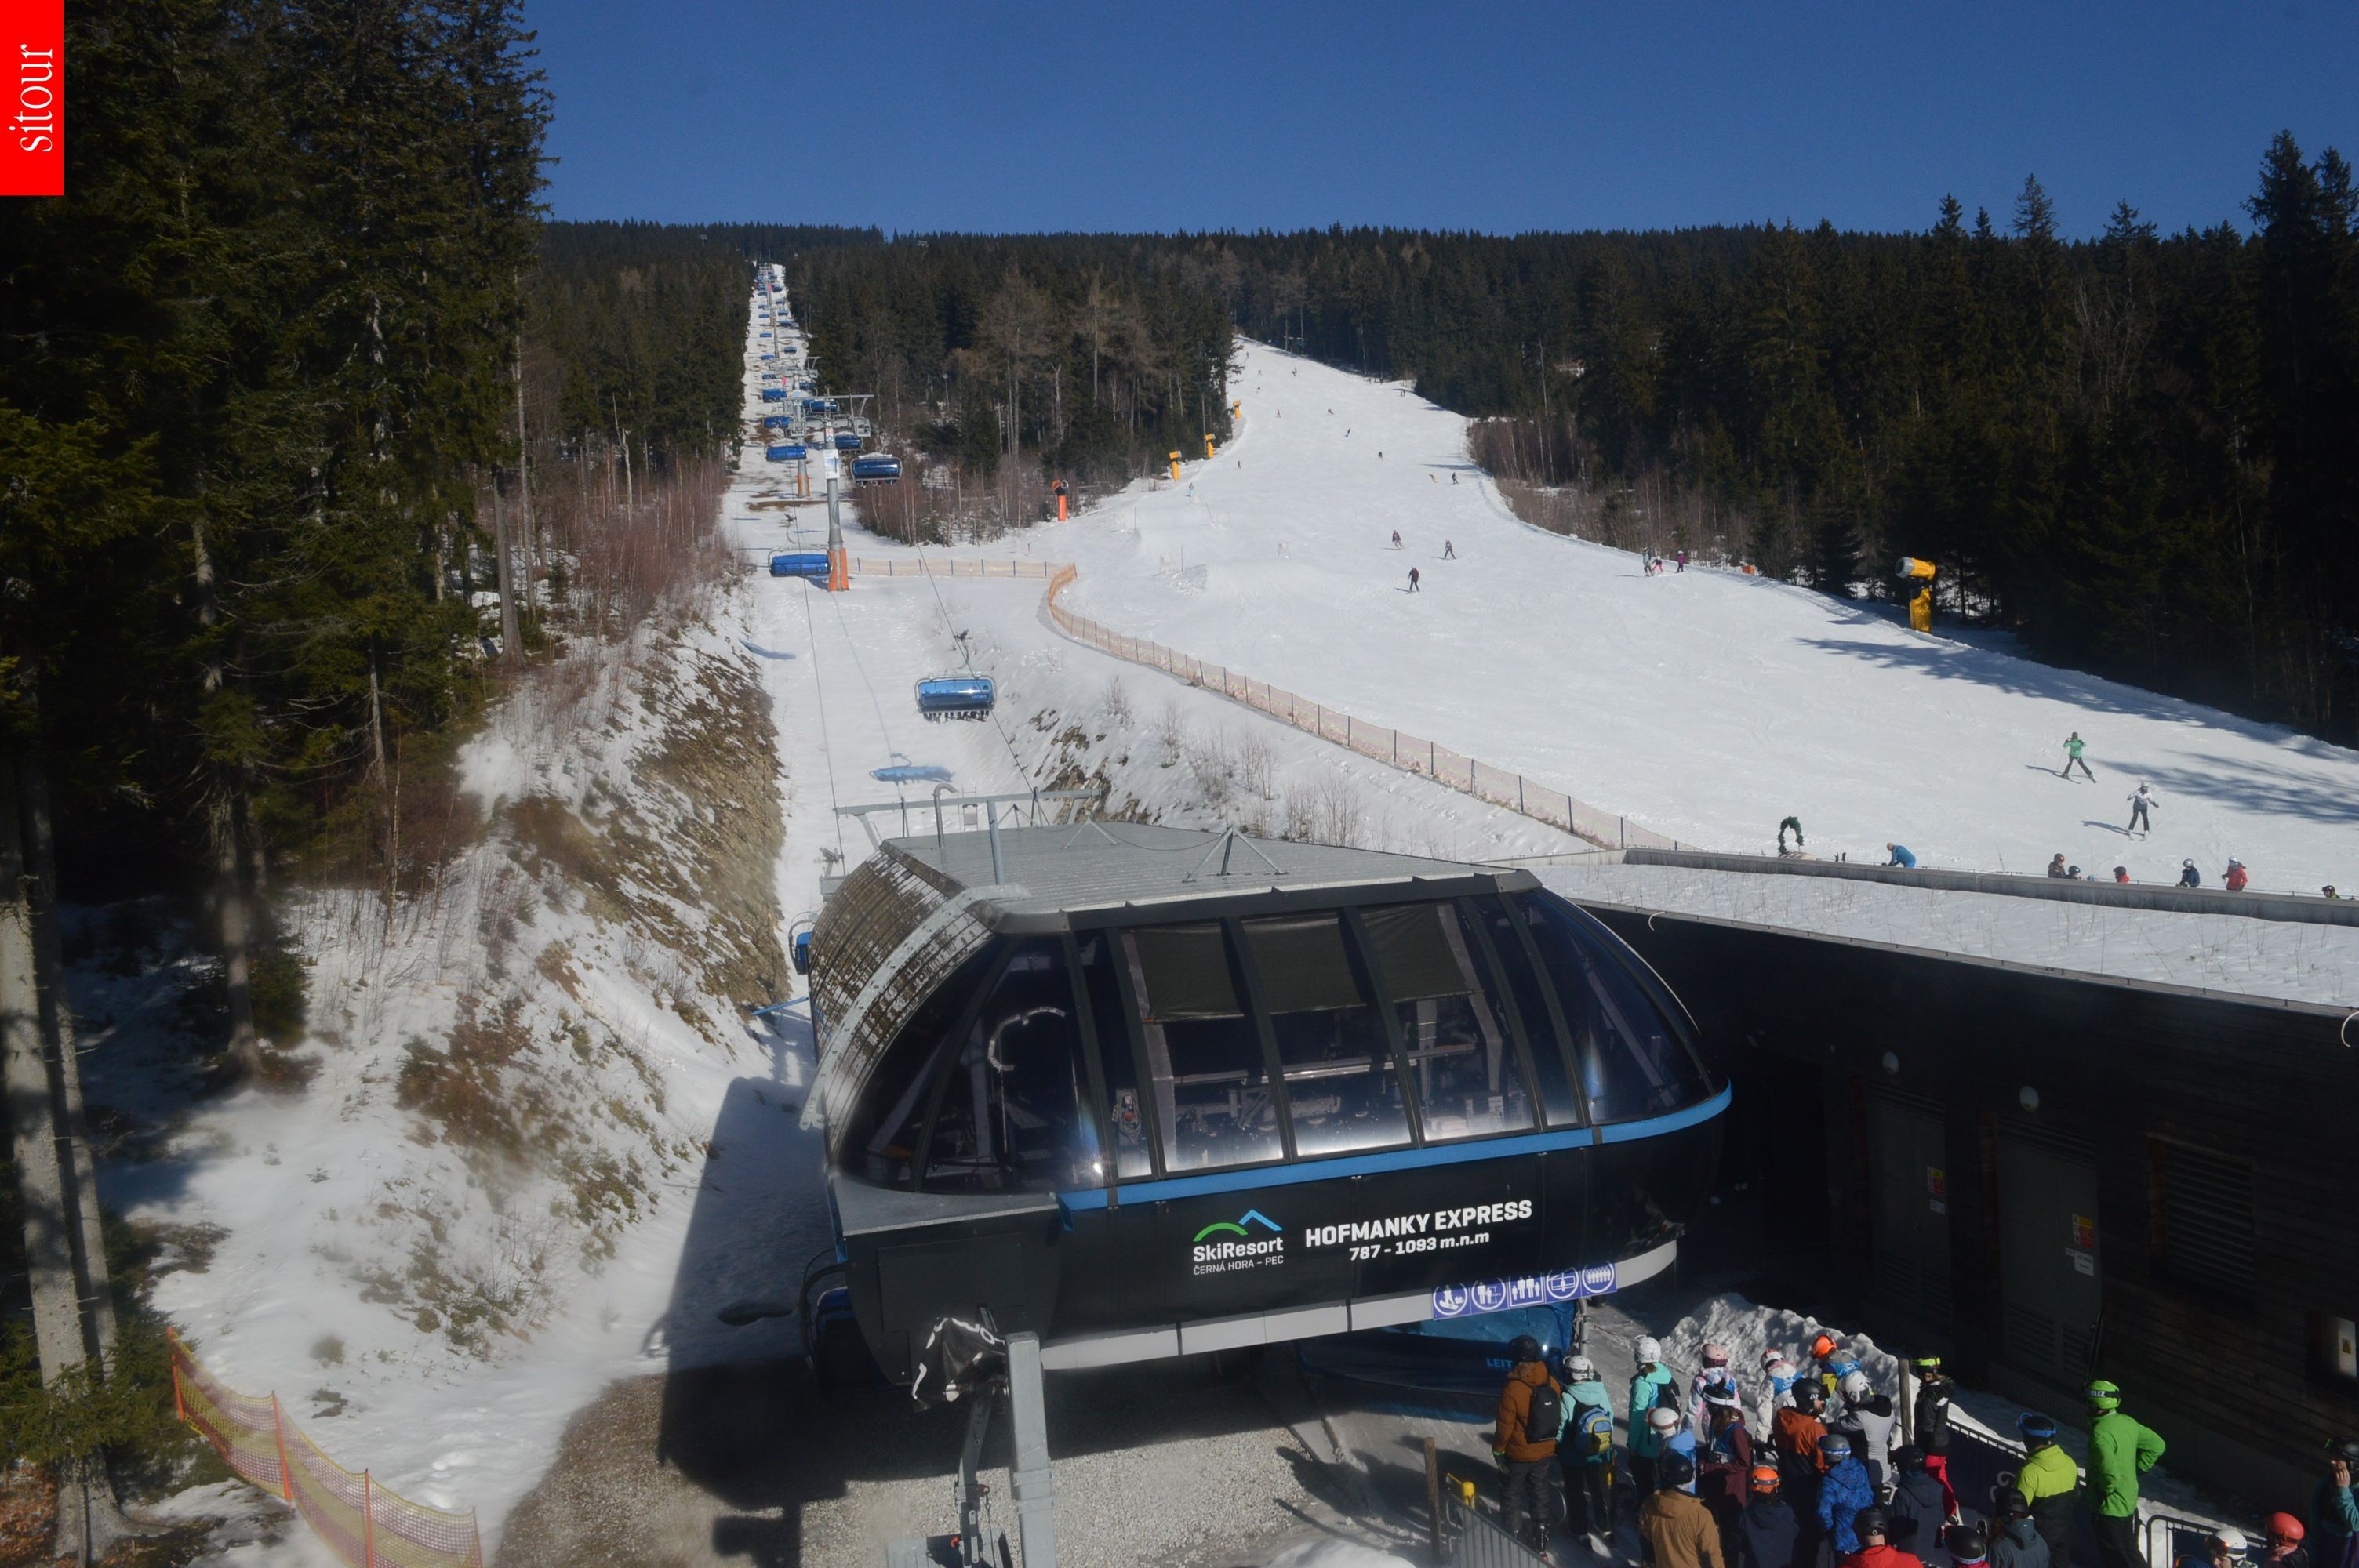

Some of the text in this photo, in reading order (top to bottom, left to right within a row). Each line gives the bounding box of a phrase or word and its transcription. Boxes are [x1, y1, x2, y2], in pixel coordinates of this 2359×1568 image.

[1305, 1200, 1532, 1247] HOFMANKY EXPRESS
[1193, 1236, 1284, 1262] SkiResort
[1349, 1244, 1381, 1261] 787
[1395, 1237, 1437, 1254] 1093
[1440, 1231, 1490, 1249] m.n.m
[1193, 1261, 1226, 1276] ČERNÁ
[1227, 1259, 1255, 1271] HORA
[1265, 1255, 1284, 1265] PEC
[1486, 1357, 1513, 1369] LEIT
